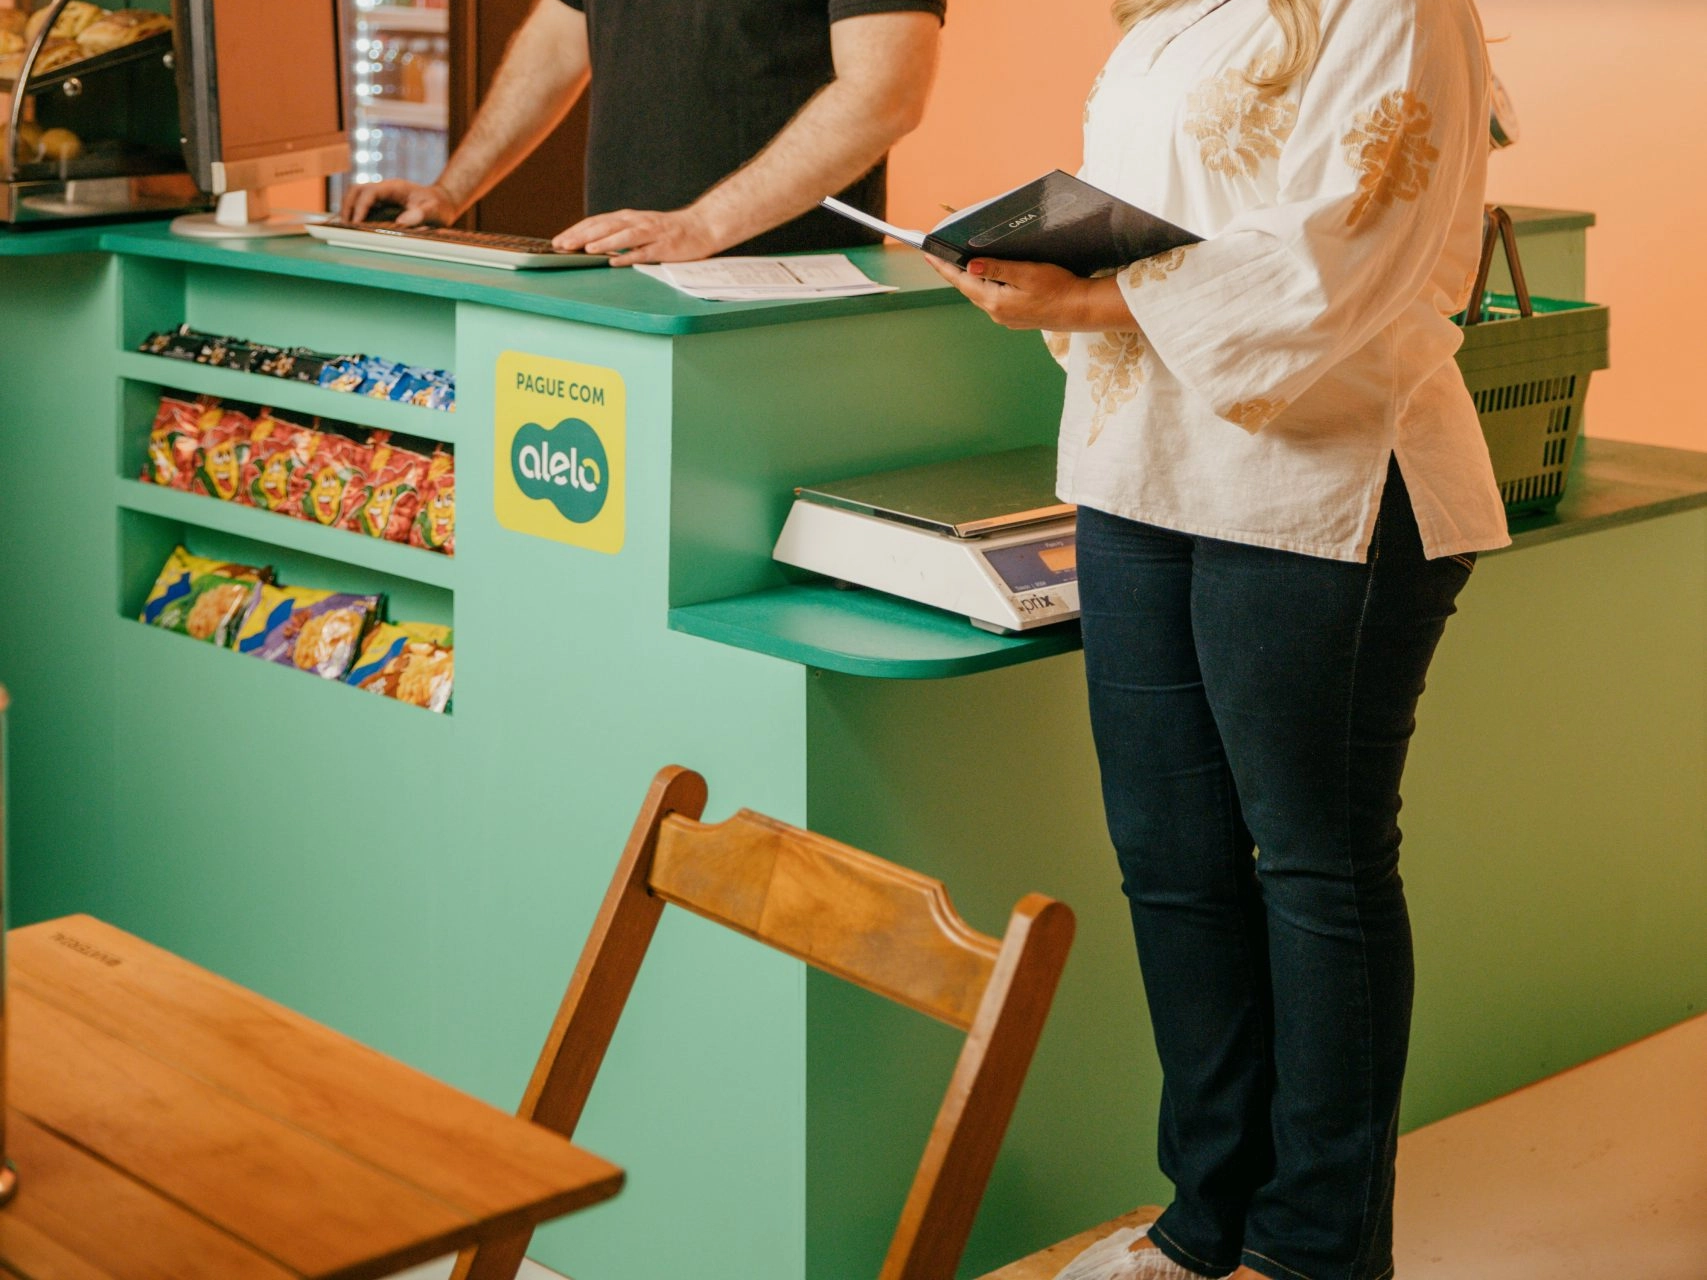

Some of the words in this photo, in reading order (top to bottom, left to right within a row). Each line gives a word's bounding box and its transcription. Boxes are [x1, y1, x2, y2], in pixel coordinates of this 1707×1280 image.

[1008, 213, 1037, 228] CAIXA
[516, 372, 565, 398] PAGUE
[569, 383, 605, 406] COM
[518, 440, 600, 493] alelo
[1020, 593, 1055, 615] prix
